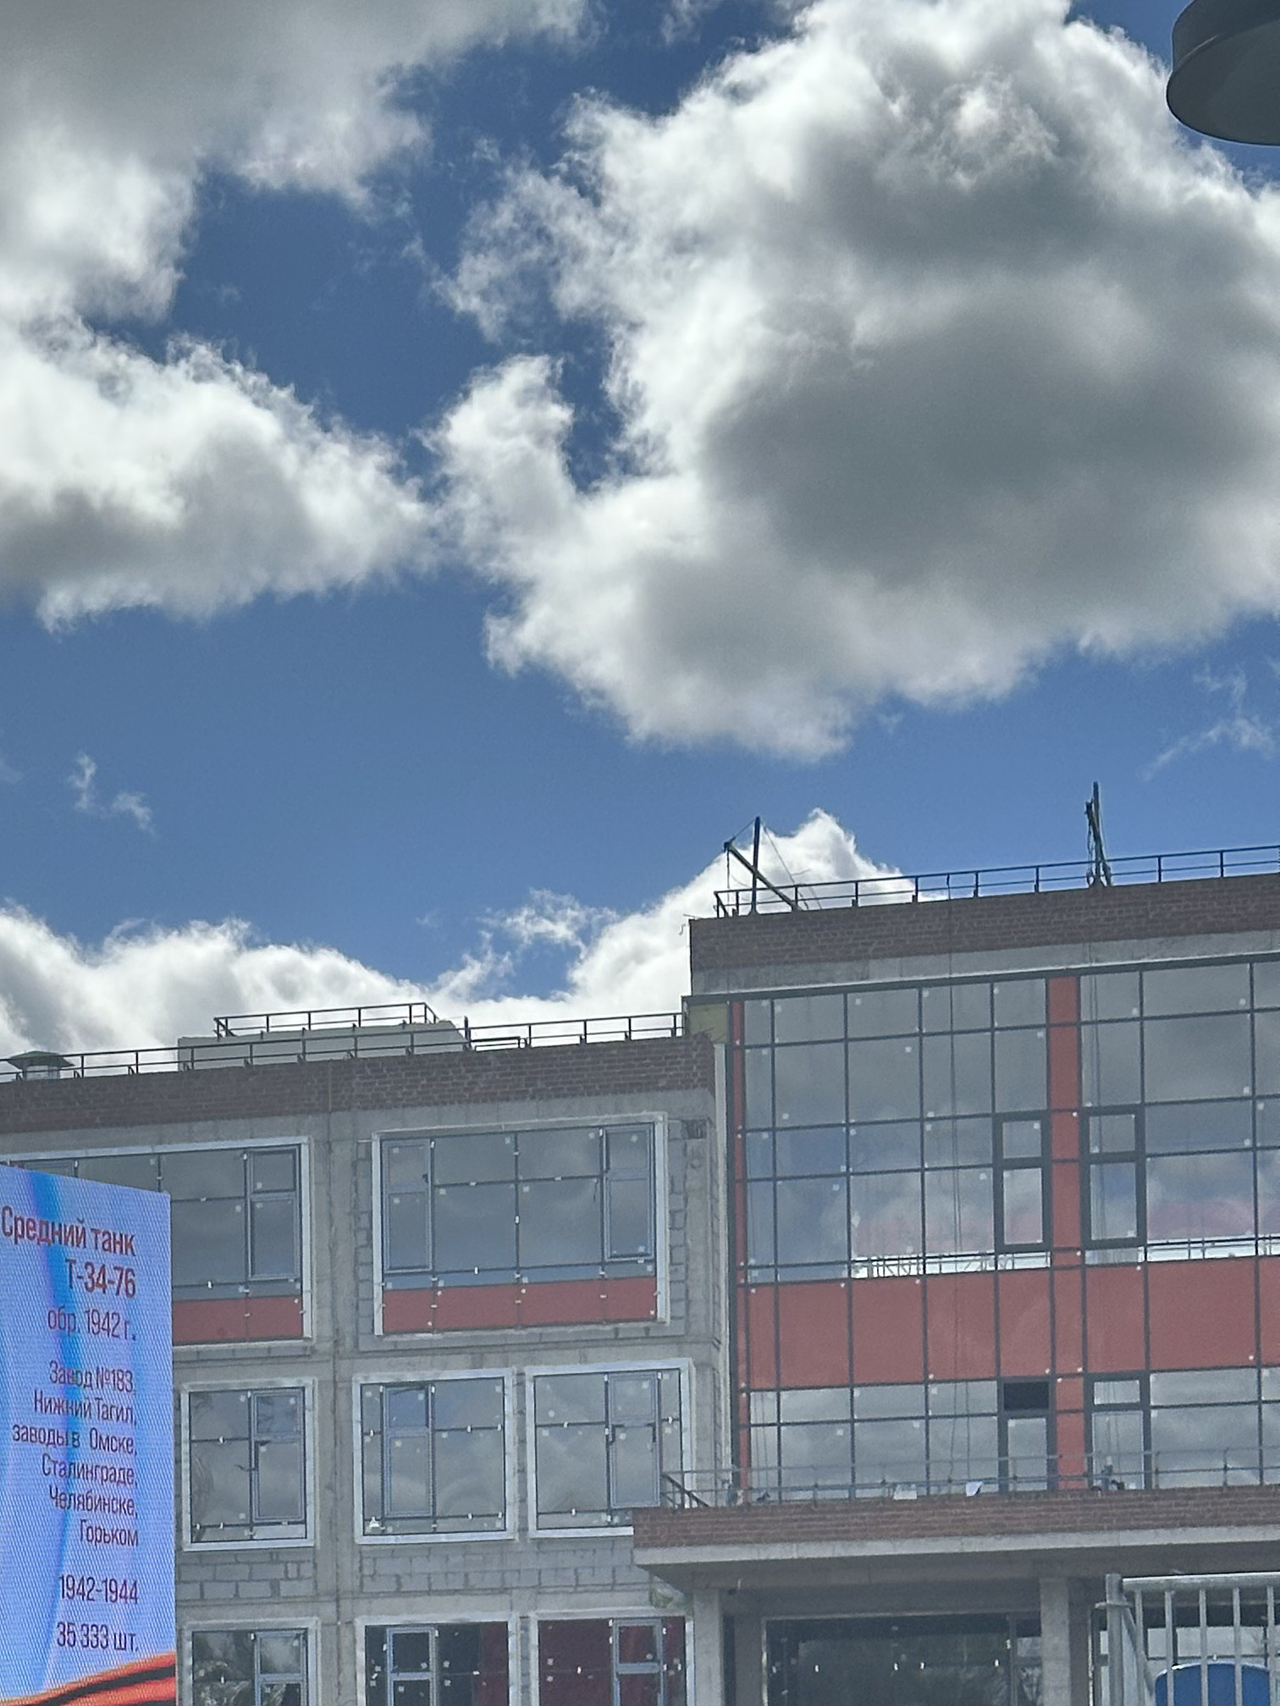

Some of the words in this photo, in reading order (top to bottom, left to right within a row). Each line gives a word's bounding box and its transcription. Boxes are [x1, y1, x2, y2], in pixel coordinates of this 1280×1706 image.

[1, 1205, 87, 1249] Средний
[90, 1228, 136, 1256] танк
[65, 1258, 136, 1298] Т-34-76
[47, 1305, 81, 1337] обр.
[85, 1308, 121, 1340] 1942
[124, 1320, 136, 1341] г.
[49, 1360, 94, 1391] Завод
[34, 1389, 91, 1419] Нижний
[94, 1397, 137, 1428] Тагил,
[12, 1424, 68, 1448] заводы
[71, 1431, 81, 1448] в
[89, 1427, 137, 1456] Омске,
[42, 1453, 138, 1488] Сталинграде,
[49, 1485, 138, 1519] Челябинске,
[80, 1519, 139, 1549] Горьком
[59, 1574, 139, 1604] 1942-1944
[113, 1631, 139, 1653] шт.
